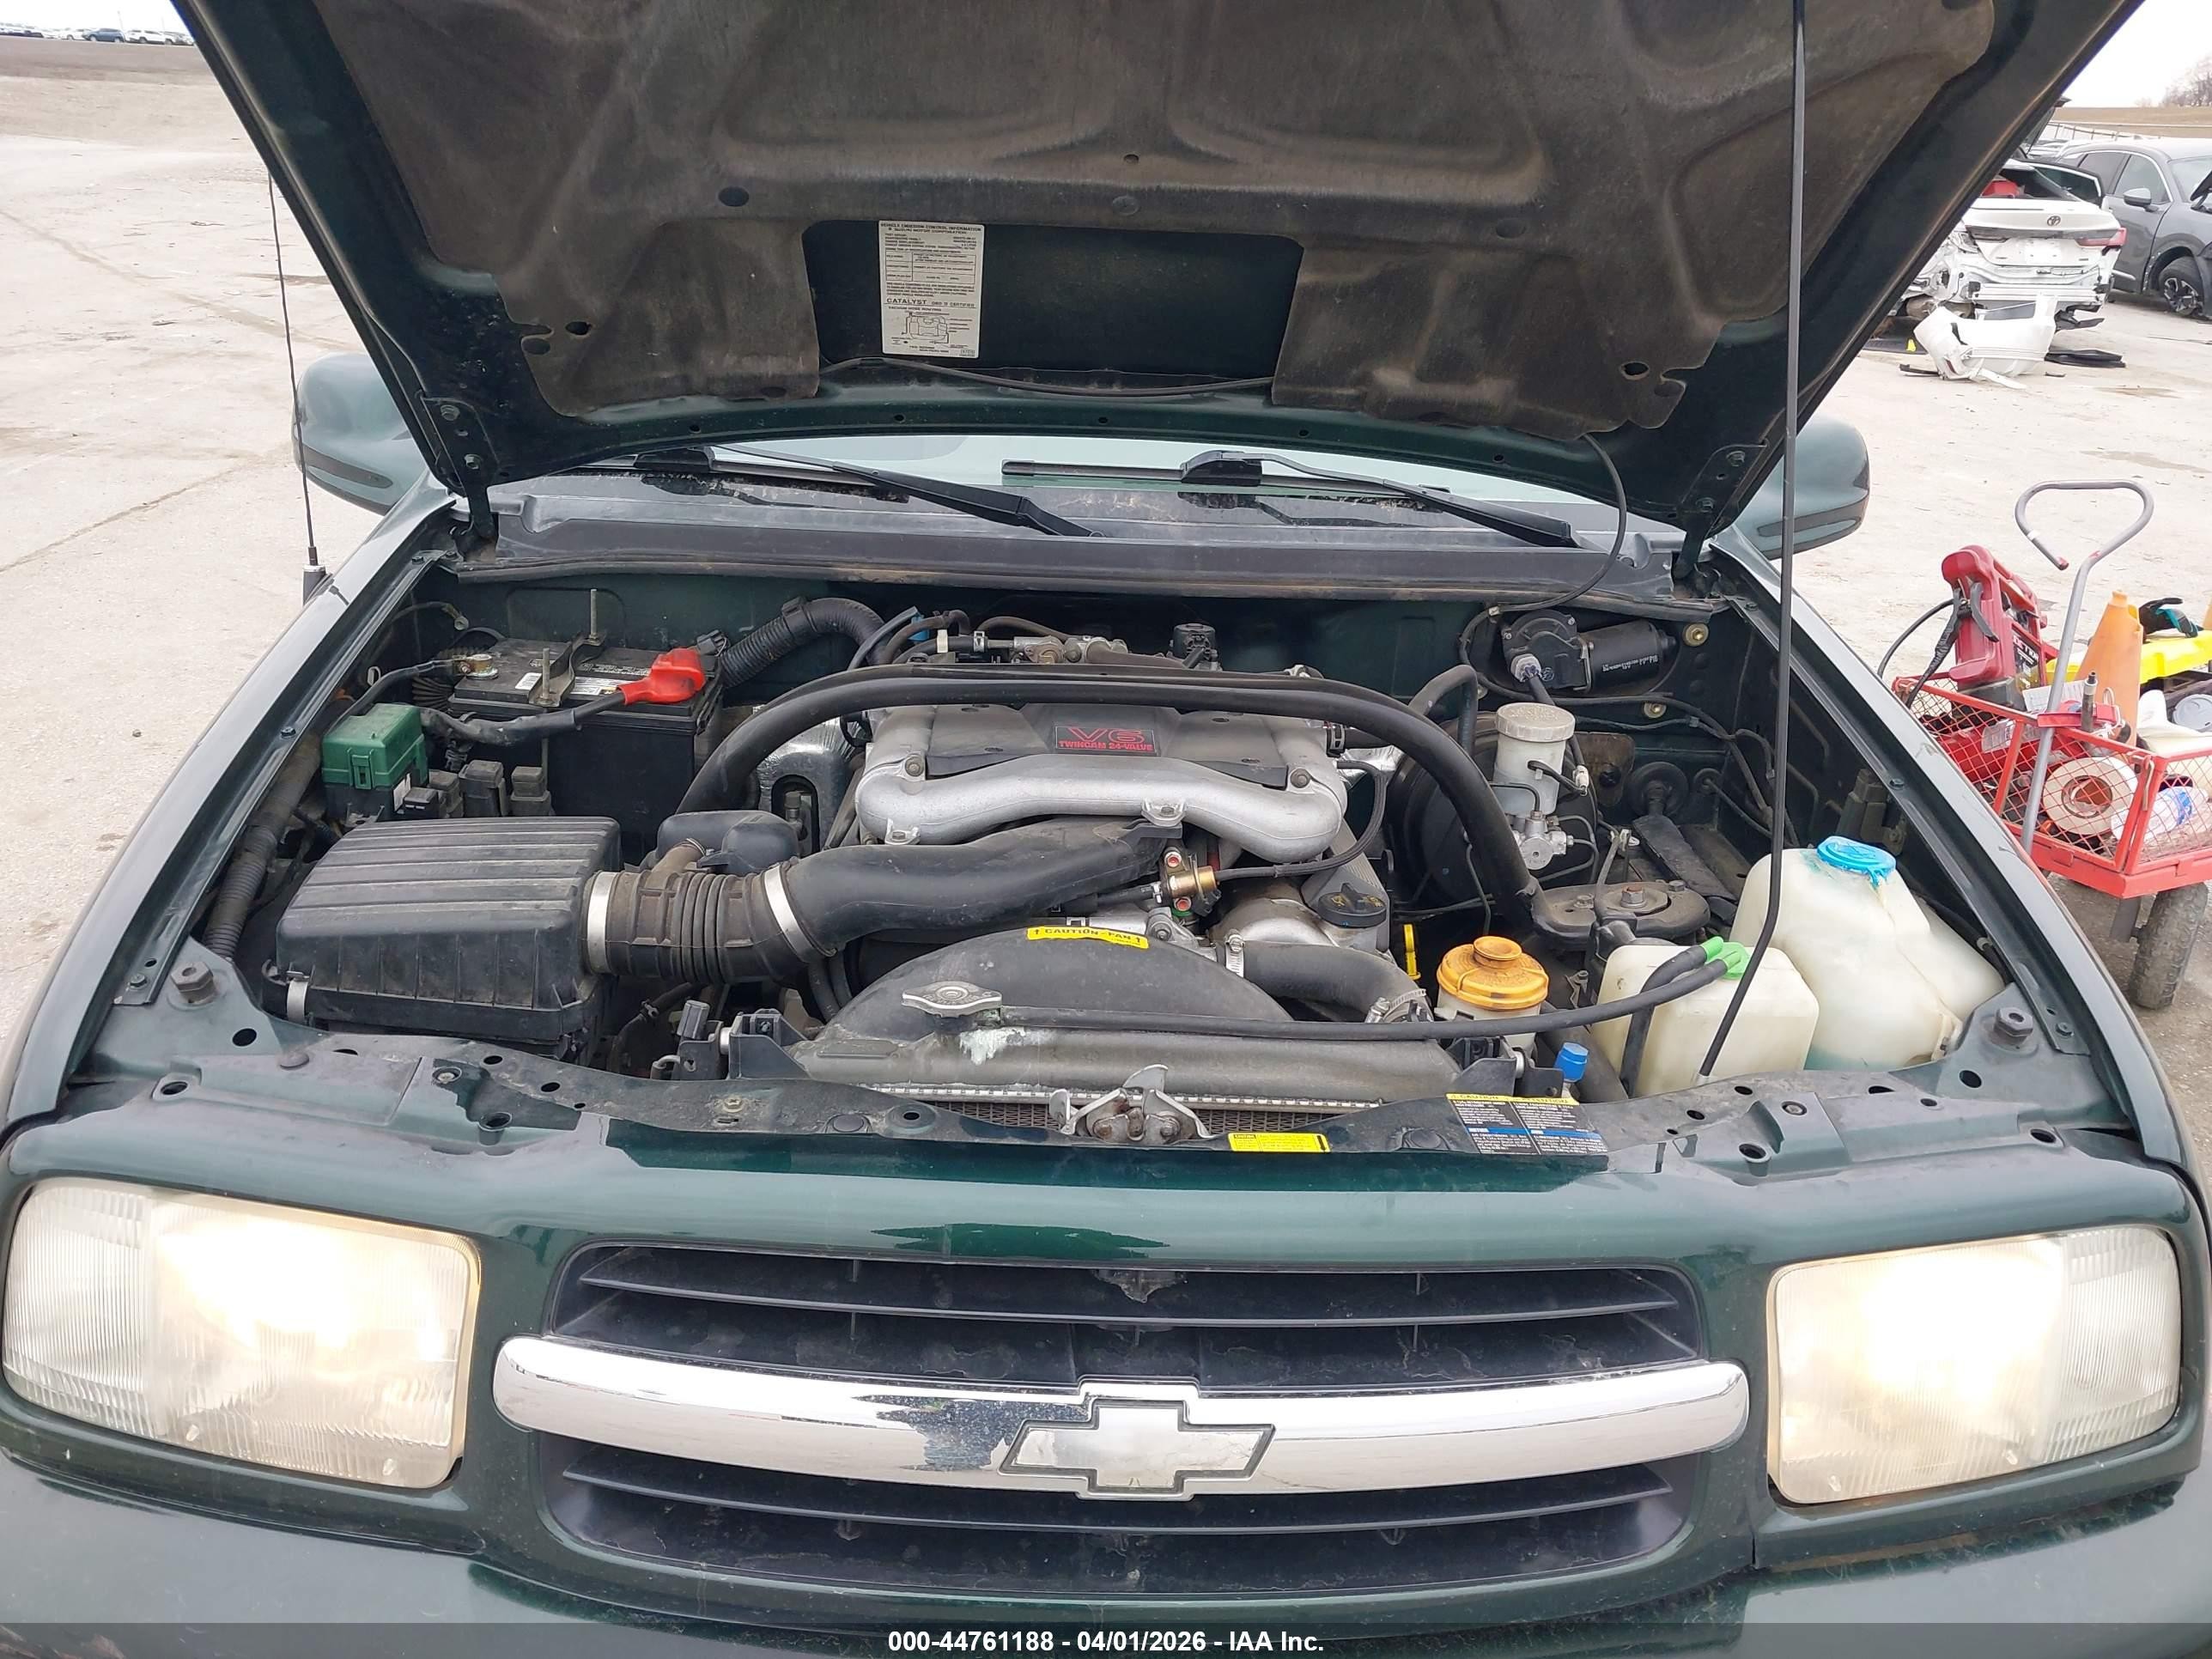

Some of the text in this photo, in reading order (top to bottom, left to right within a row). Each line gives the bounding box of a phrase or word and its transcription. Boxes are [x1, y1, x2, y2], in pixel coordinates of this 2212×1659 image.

[1067, 727, 1145, 744] V6
[1058, 741, 1153, 751] TWINCAM 24-VALVE
